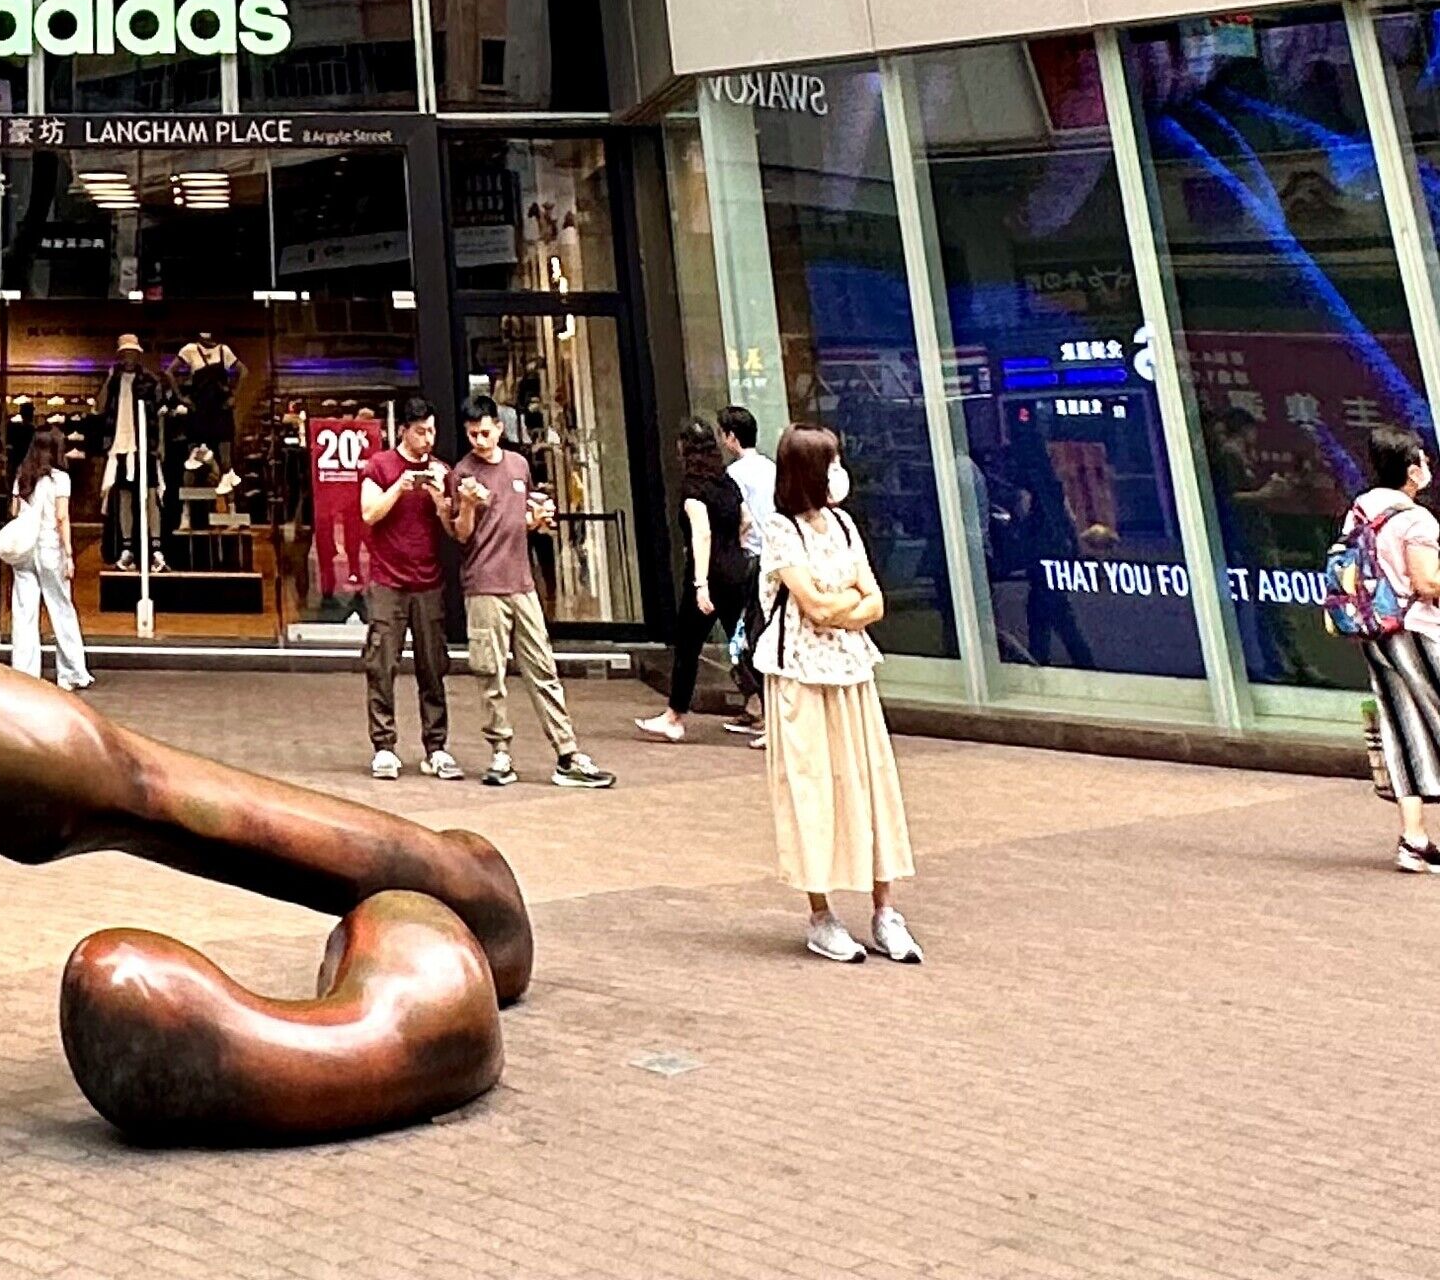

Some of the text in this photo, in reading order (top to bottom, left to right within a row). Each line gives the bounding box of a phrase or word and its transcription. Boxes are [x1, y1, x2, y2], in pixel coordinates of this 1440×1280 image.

[85, 120, 292, 143] LANGHAM PLACE
[1040, 559, 1328, 605] THAT YOU FOET ABOU
